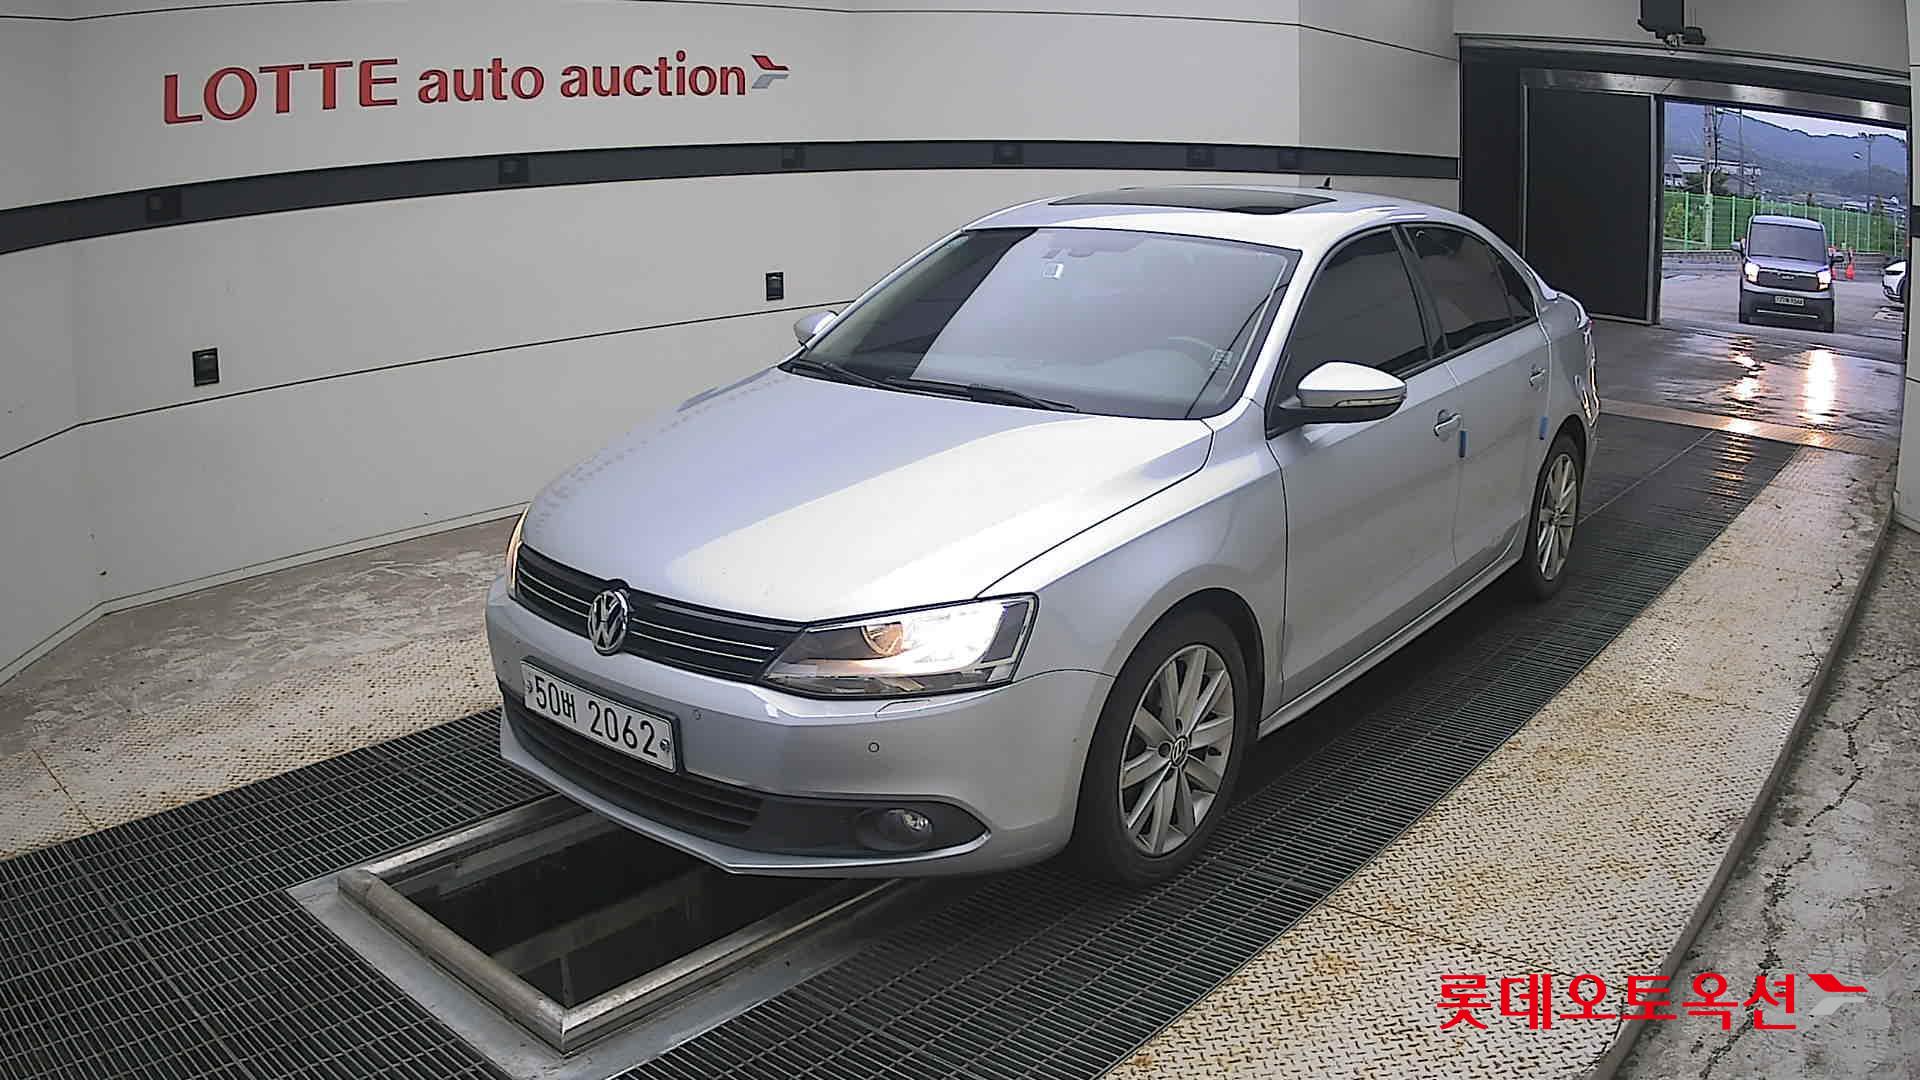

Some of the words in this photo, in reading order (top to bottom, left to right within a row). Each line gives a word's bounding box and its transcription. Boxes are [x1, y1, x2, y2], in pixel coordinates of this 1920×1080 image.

[164, 58, 398, 125] LOTTE
[417, 57, 545, 103] auto
[559, 50, 746, 98] auction
[534, 675, 577, 723] 50버
[588, 700, 658, 757] 2062
